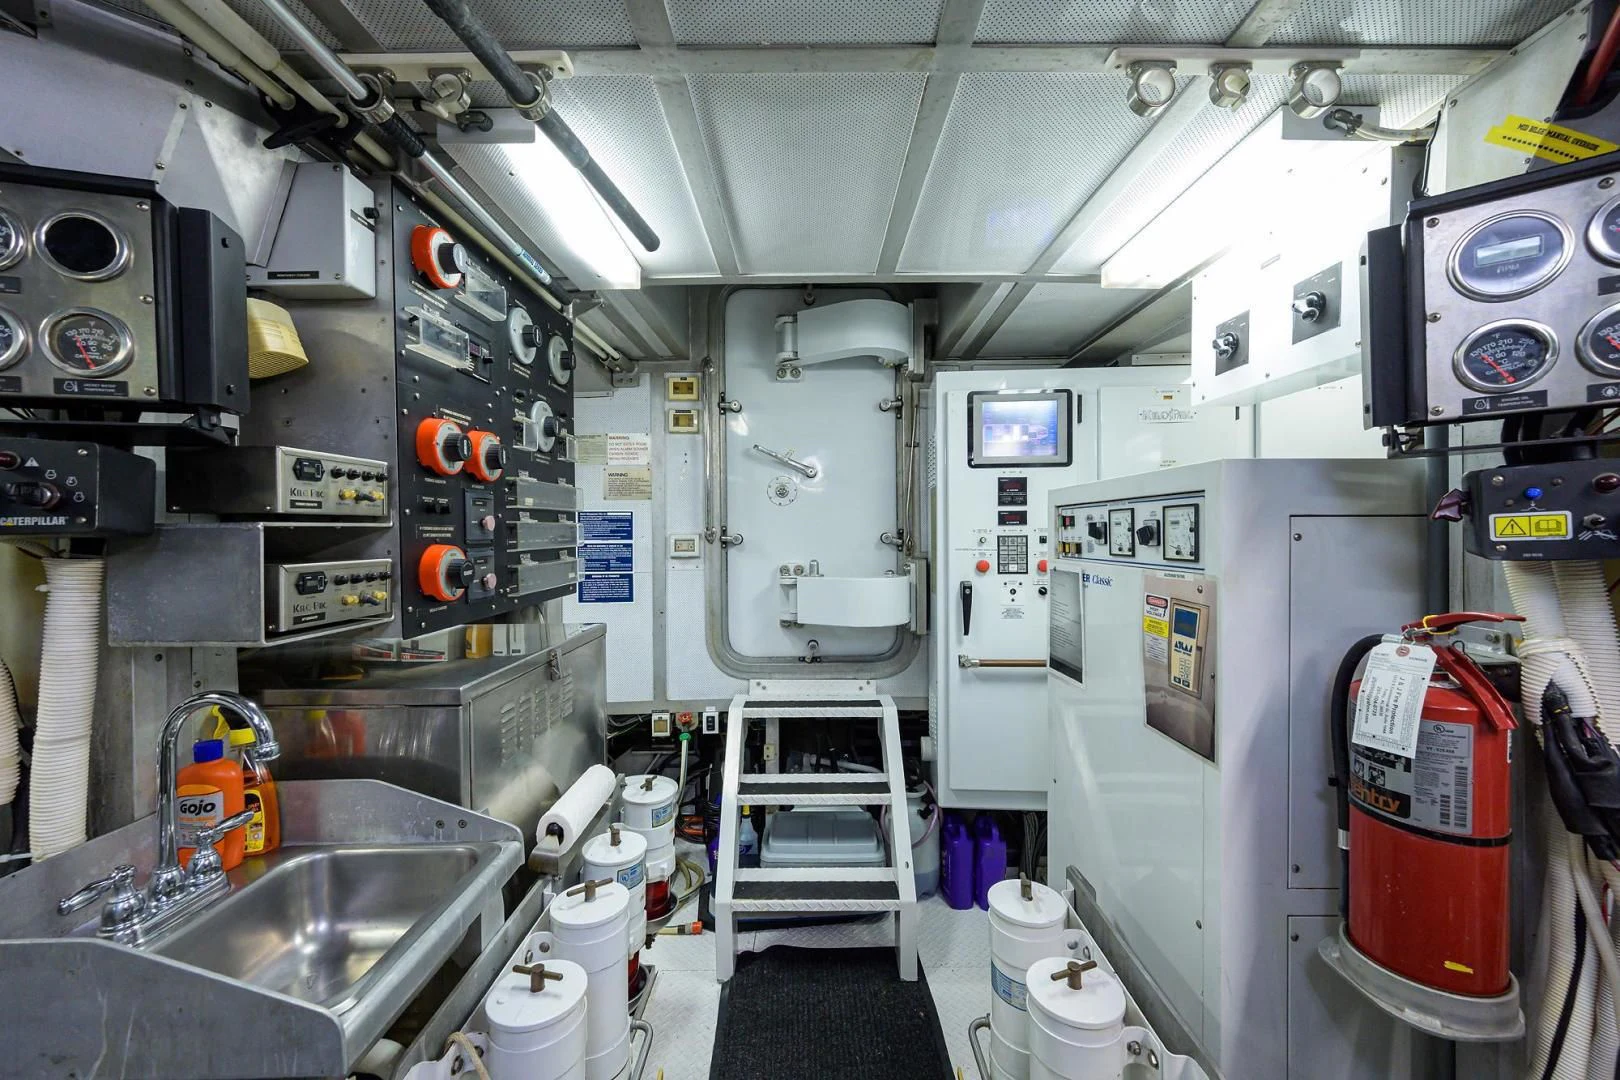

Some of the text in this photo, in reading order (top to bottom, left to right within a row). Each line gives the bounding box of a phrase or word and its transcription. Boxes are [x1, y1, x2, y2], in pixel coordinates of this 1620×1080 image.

[0, 516, 66, 526] CATERPILLAR
[1082, 573, 1113, 587] ER Classic
[1389, 703, 1399, 734] Protection
[1352, 783, 1400, 813] entry
[180, 800, 216, 816] GOJO
